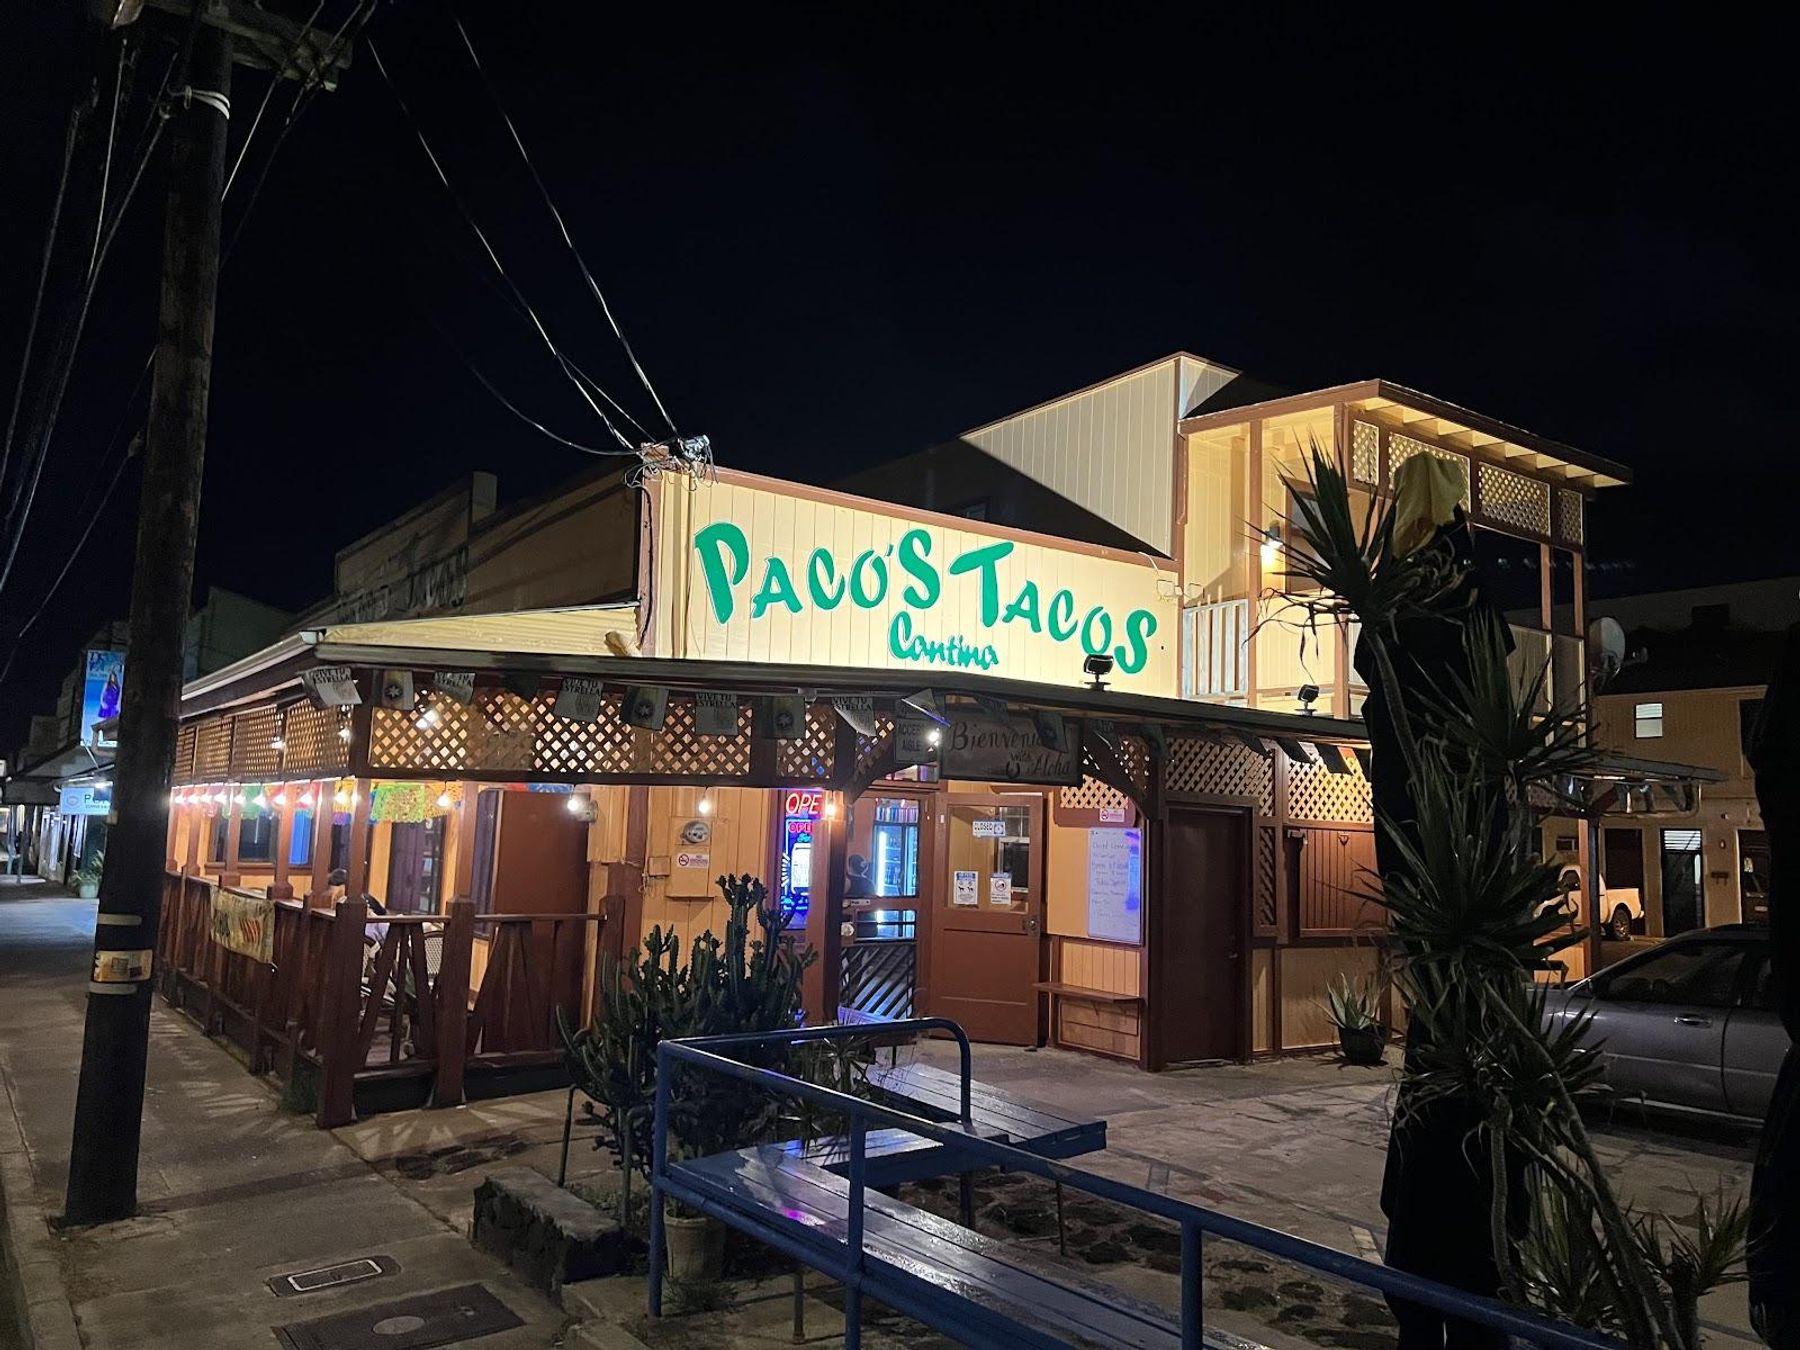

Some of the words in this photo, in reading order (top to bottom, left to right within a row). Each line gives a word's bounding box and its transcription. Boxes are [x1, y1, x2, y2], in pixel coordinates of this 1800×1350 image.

[694, 521, 941, 625] PACO'S
[949, 541, 1158, 675] TACOS
[889, 611, 999, 670] Cantina
[1031, 752, 1072, 777] Aloha
[786, 793, 822, 815] OPE
